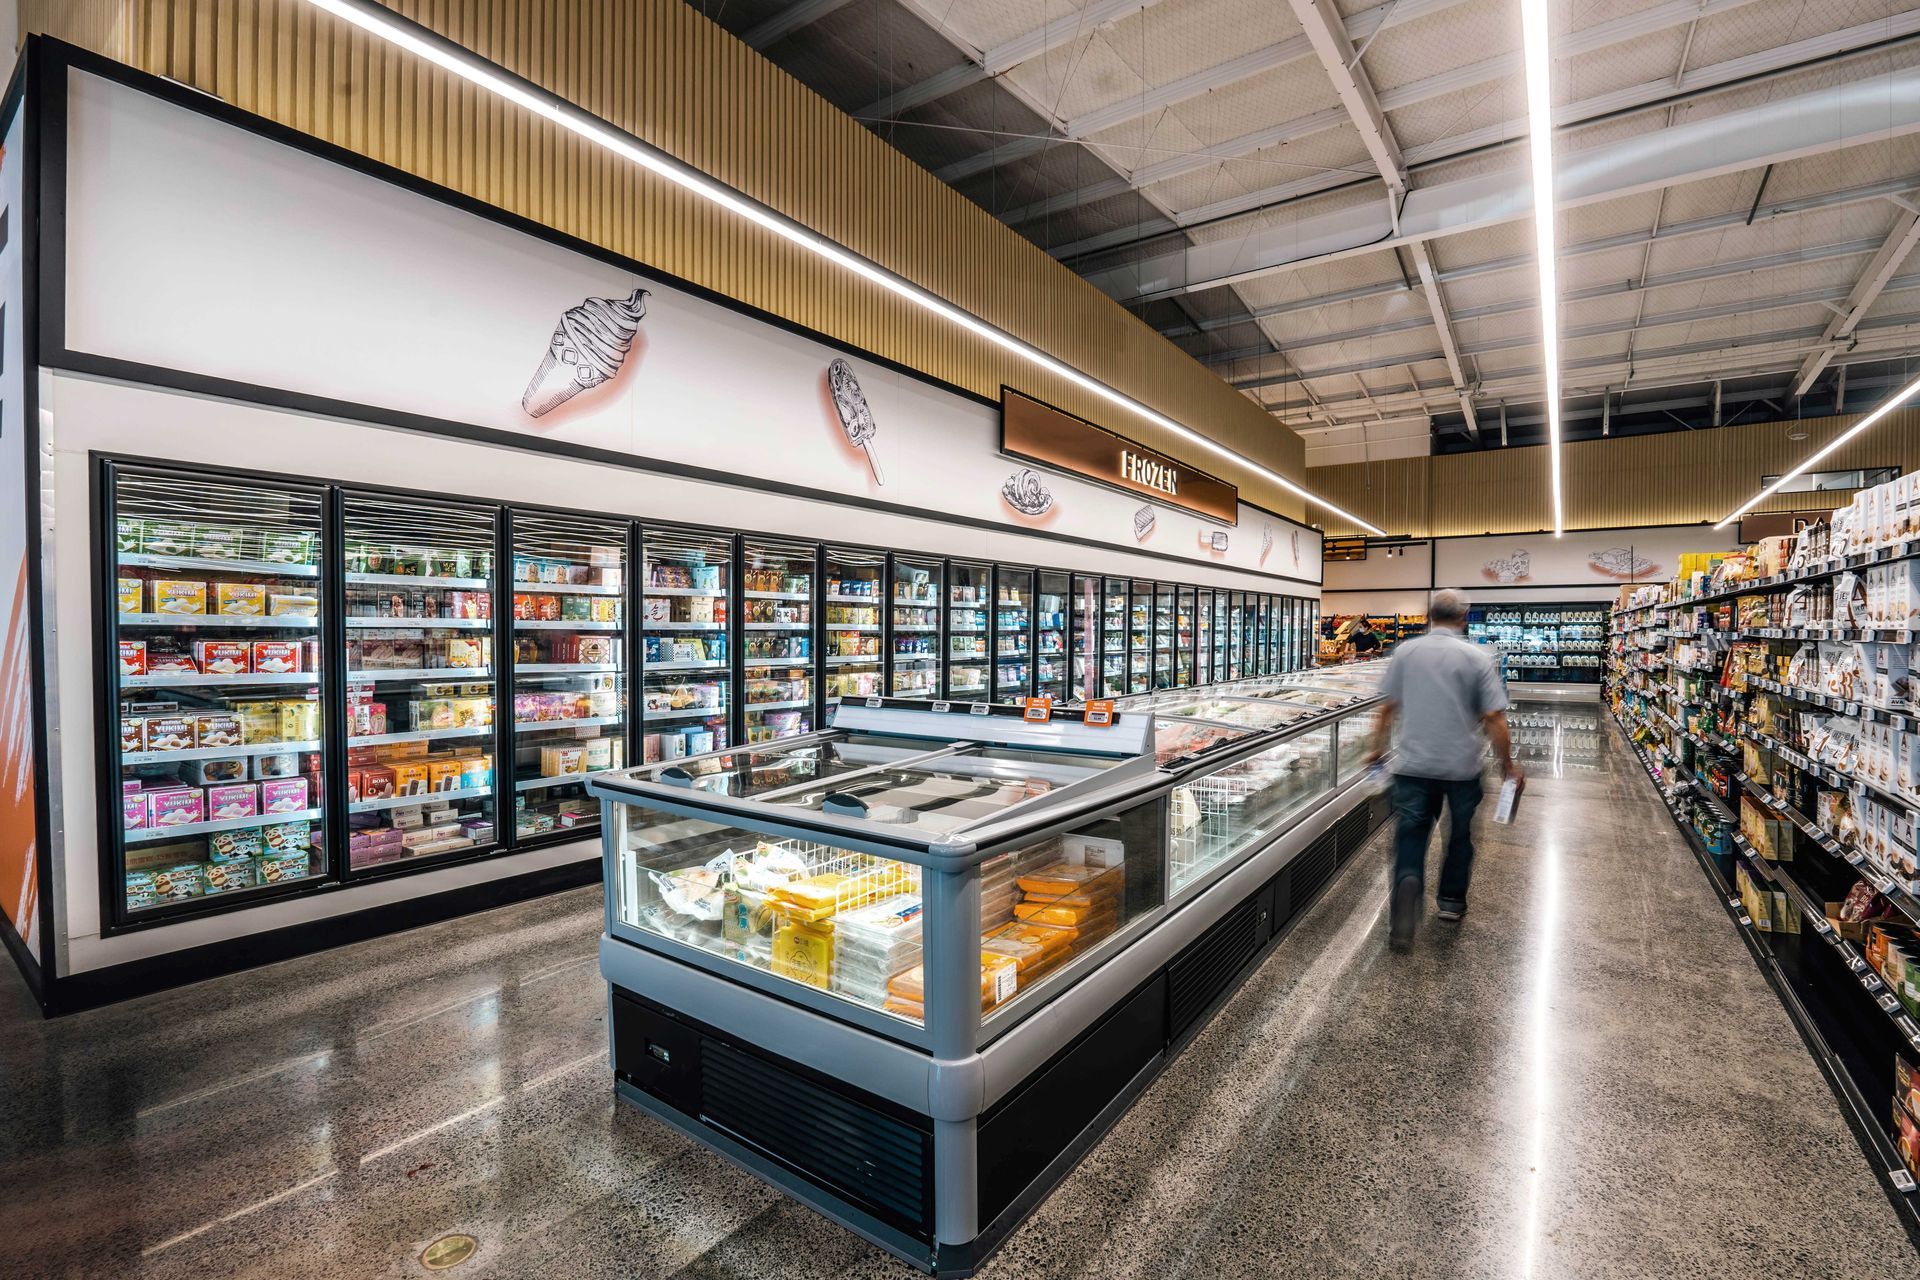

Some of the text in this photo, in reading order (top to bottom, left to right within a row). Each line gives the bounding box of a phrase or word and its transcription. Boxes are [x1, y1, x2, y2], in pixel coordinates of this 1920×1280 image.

[1121, 450, 1178, 495] FROZEN
[166, 588, 196, 597] YUKIMI
[228, 590, 257, 598] YUKIMI
[212, 649, 242, 657] YUKIMI
[262, 649, 290, 657] YUKIMI
[155, 724, 187, 732] YUKIMI
[205, 722, 236, 730] YUKIMI
[272, 788, 300, 796] YUKIMI
